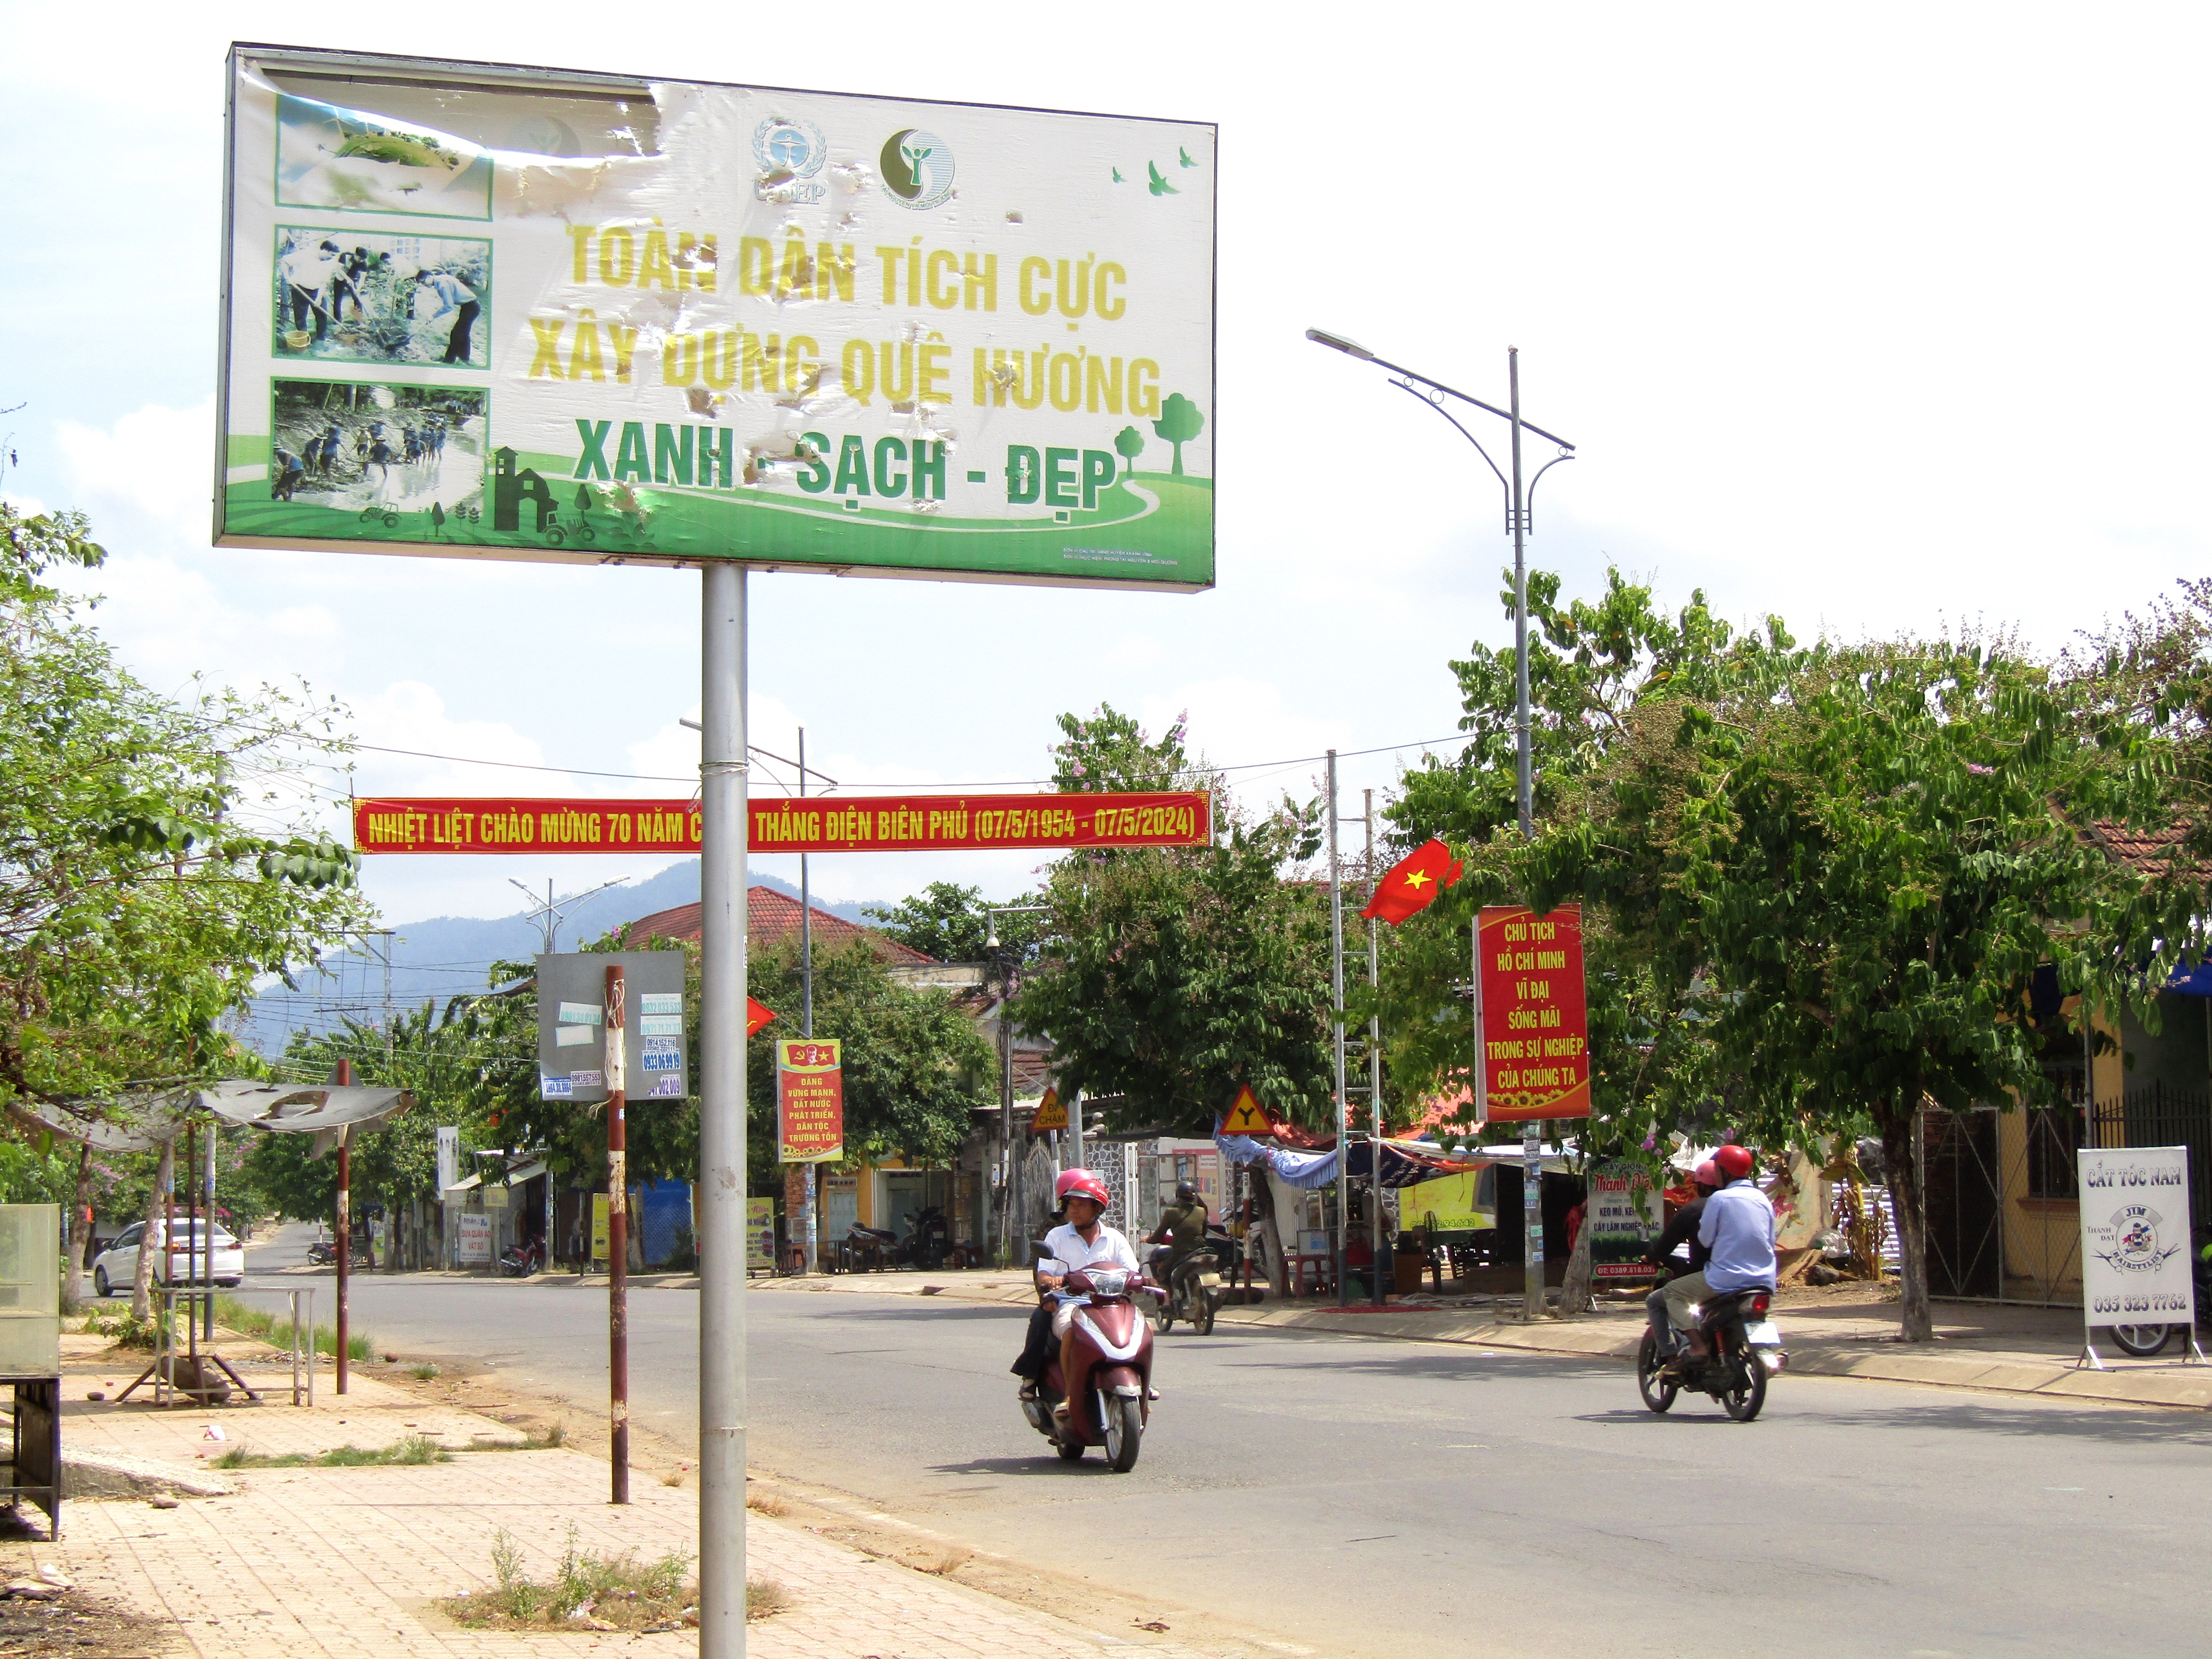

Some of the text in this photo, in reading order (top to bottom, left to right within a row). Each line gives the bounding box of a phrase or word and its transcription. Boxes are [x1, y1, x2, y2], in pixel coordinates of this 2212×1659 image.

[566, 217, 1126, 331] TOÀN DÂN TÍCH CỰC
[529, 308, 1161, 418] XÂY DỰNG QUÊ HƯƠNG
[574, 419, 733, 488] XANH
[796, 431, 945, 510] SẠCH
[1006, 444, 1116, 522] ĐẸP
[369, 807, 427, 850] NHIỆT
[434, 807, 474, 850] LIỆT
[480, 806, 534, 844] CHÀO
[541, 806, 601, 843] MỪNG
[607, 813, 631, 843] 70
[638, 807, 683, 843] NĂM
[755, 802, 820, 842] THẮNG
[826, 805, 871, 847] ĐIỆN
[878, 805, 920, 840] BIÊN
[929, 799, 968, 840] PHỦ
[975, 808, 1076, 842] (07/5/1954
[1094, 806, 1195, 839] 07/5/2024)
[1504, 916, 1555, 945] CHỦ TỊCH
[1497, 945, 1565, 972] HỒ CHÍ MINH
[1516, 977, 1549, 1003] VĨ ĐẠI
[1508, 1004, 1560, 1030] SỐNG MÃI
[1487, 1033, 1584, 1061] TRONG SỰ NGHIỆP
[801, 1076, 823, 1085] ĐẢNG
[1498, 1063, 1577, 1089] CỦA CHÚNG TA
[796, 1121, 829, 1132] DÂN TỘC
[2087, 1160, 2182, 1188] CẮT TÓC NAM
[1599, 1207, 1610, 1216] KEO
[2126, 1207, 2146, 1216] JIM
[1594, 1222, 1606, 1232] CÂY
[2112, 1250, 2163, 1270] HAIRSTYLIST
[2094, 1294, 2186, 1313] 035 323 7762
